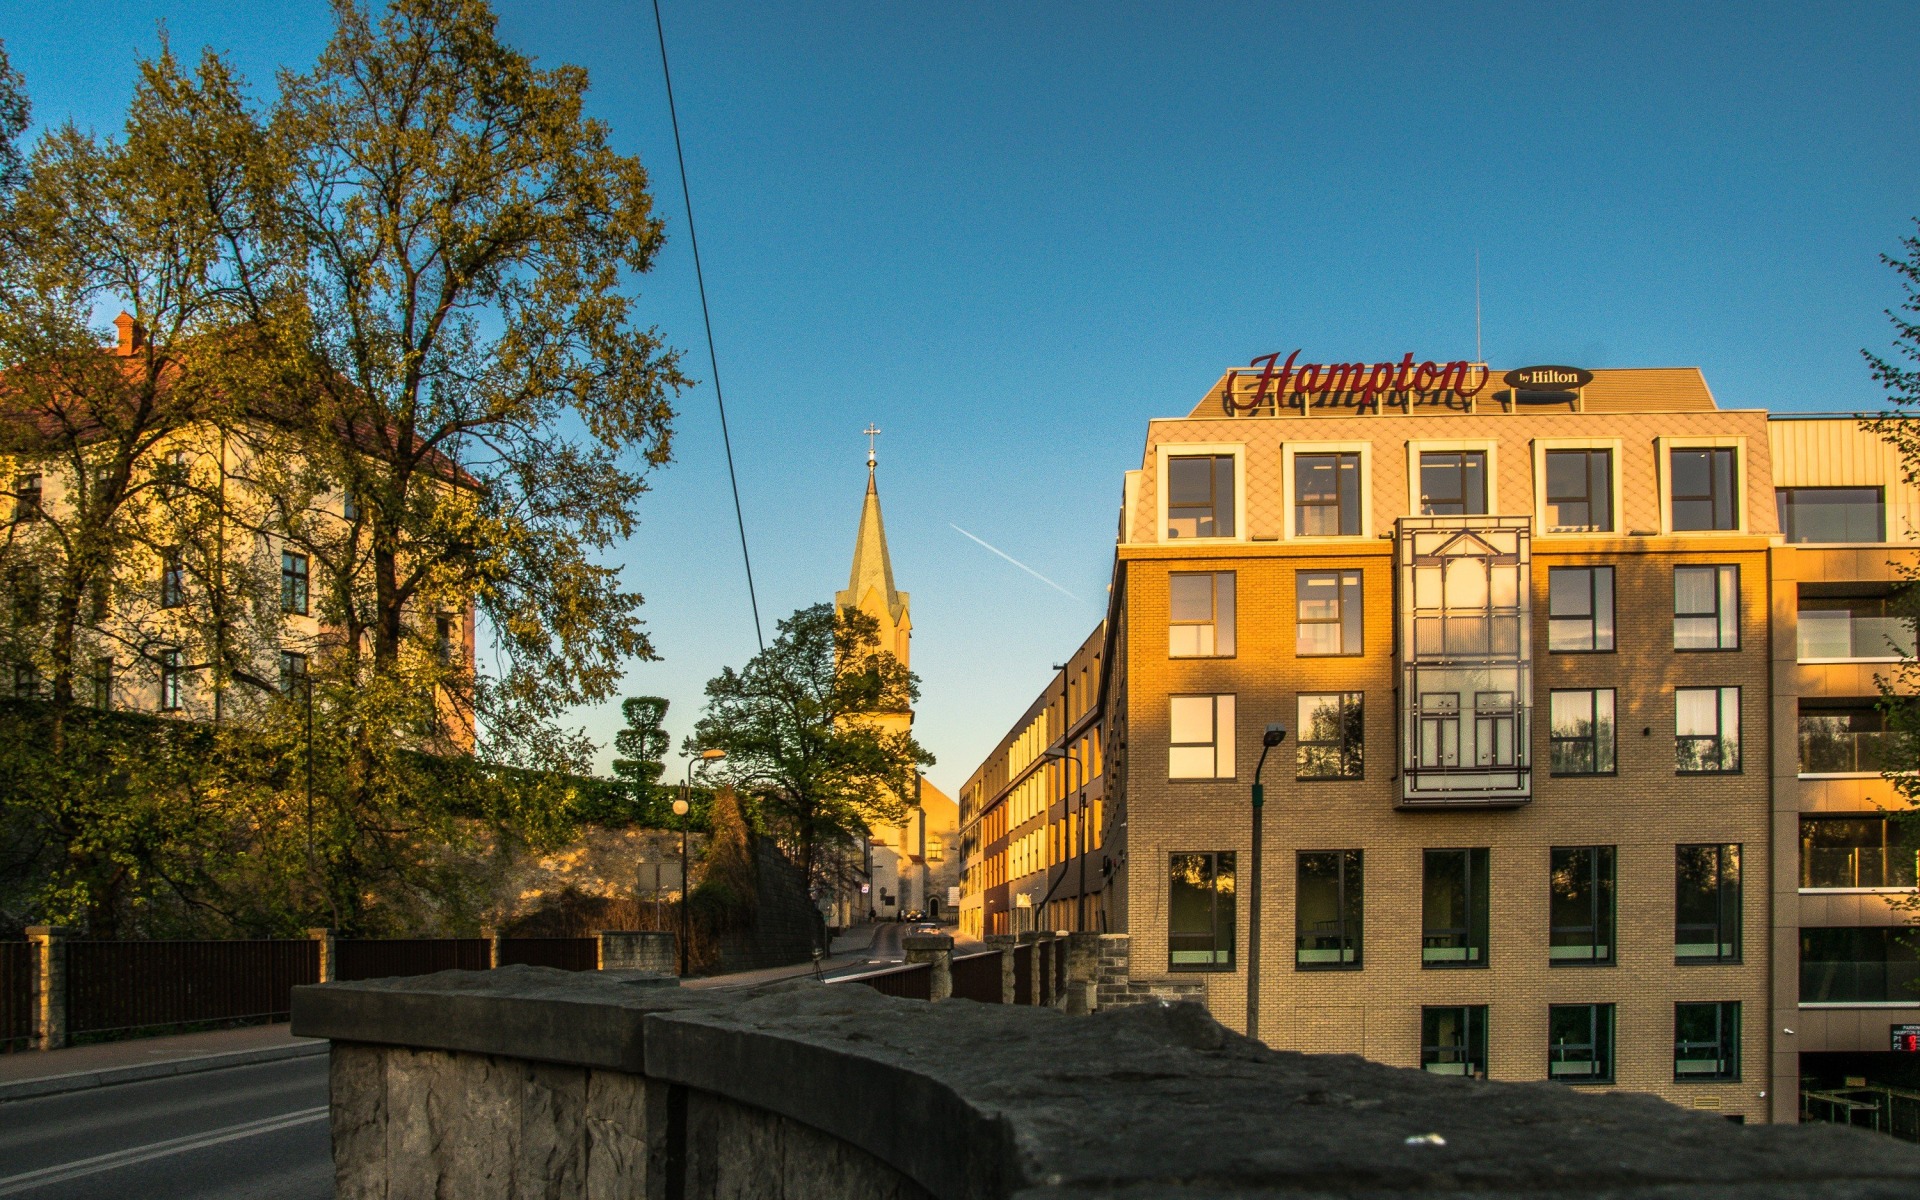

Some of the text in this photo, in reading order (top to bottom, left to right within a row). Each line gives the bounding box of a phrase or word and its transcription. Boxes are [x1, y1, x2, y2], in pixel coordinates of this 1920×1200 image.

[1227, 349, 1490, 410] Hampton
[1519, 370, 1578, 383] by Hilton
